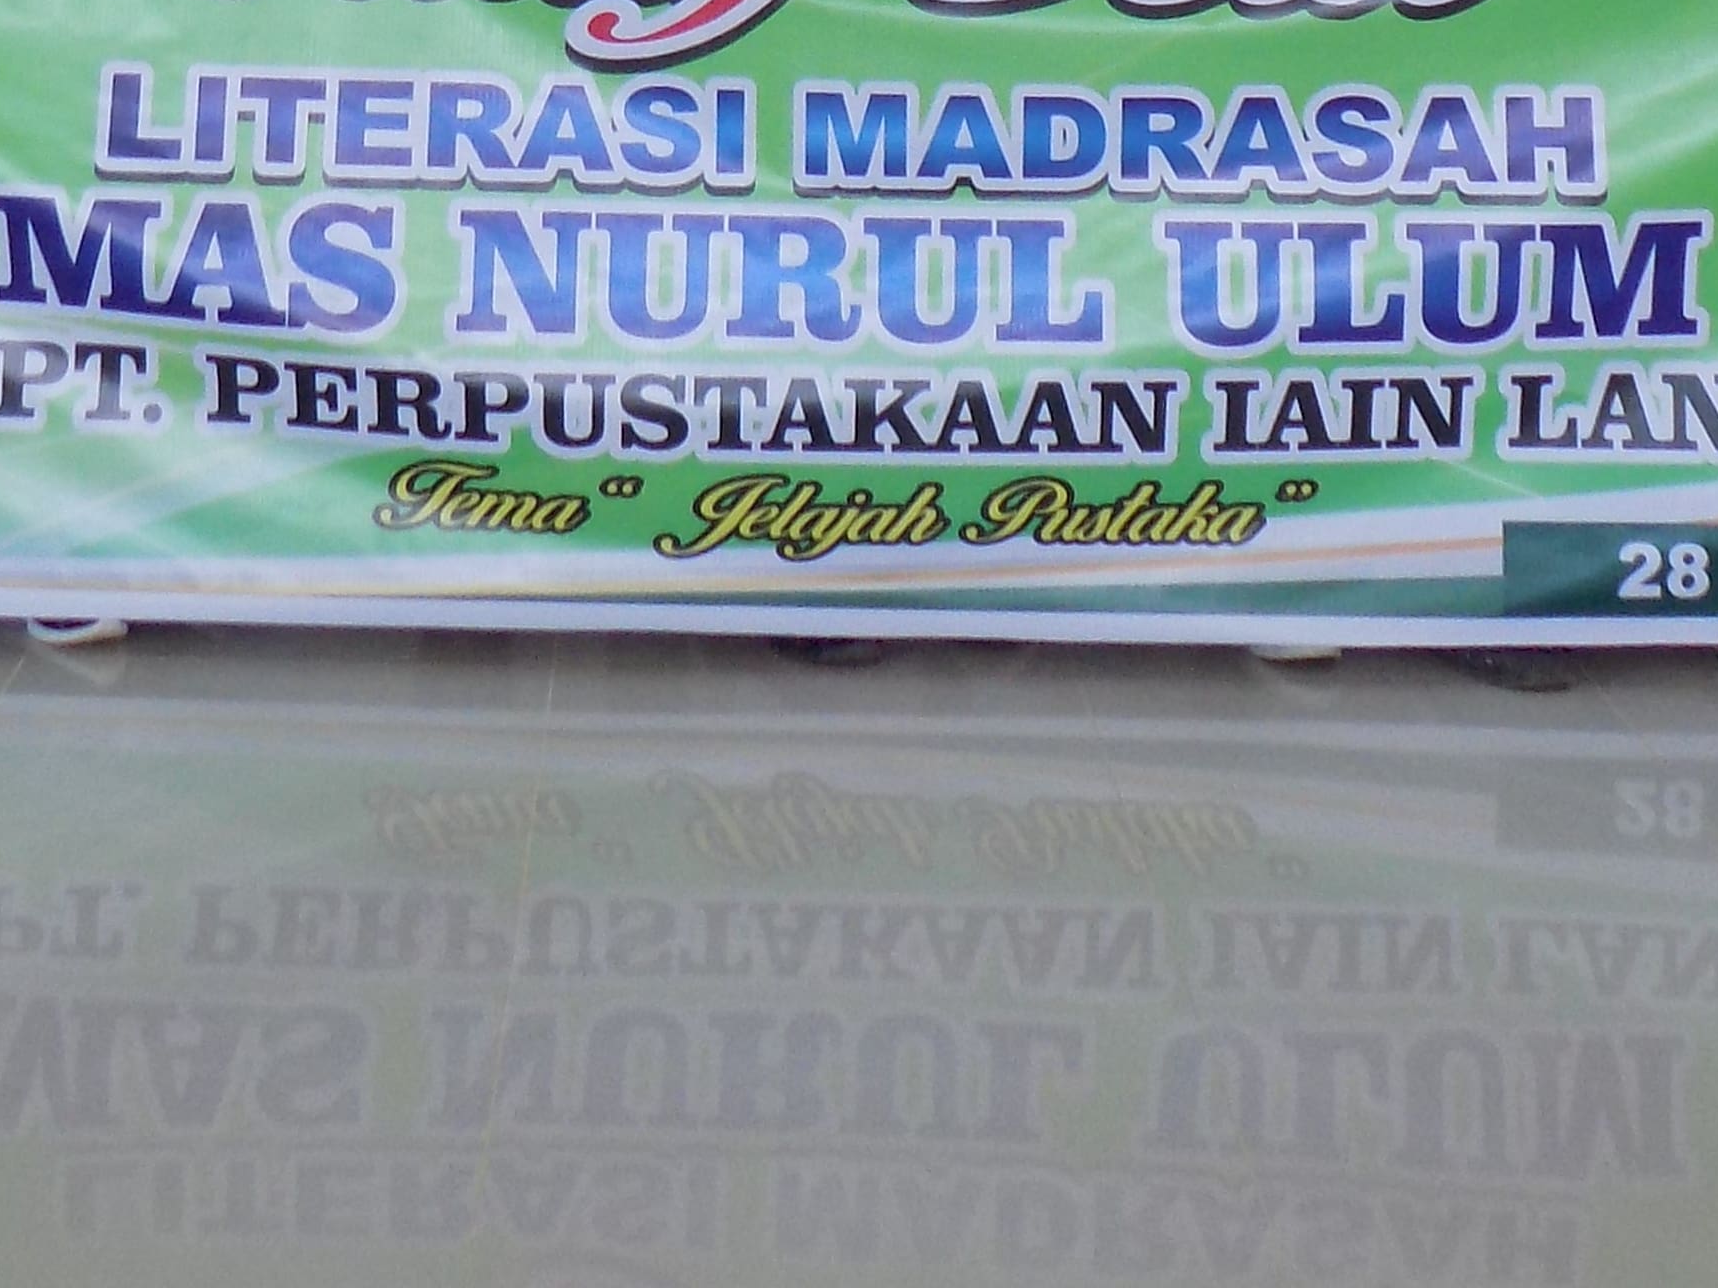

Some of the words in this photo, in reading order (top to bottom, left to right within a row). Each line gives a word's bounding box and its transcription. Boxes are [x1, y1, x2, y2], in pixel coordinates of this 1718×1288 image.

[101, 72, 747, 181] LITERASI
[799, 89, 1607, 188] MADRASAH
[453, 206, 1105, 346] NURUL
[1163, 216, 1705, 346] ULUM
[205, 354, 1171, 454] PERPUSTAKAAN
[1215, 374, 1469, 452] IAIN
[651, 472, 951, 562] Jelajah
[1617, 540, 1715, 602] 28
